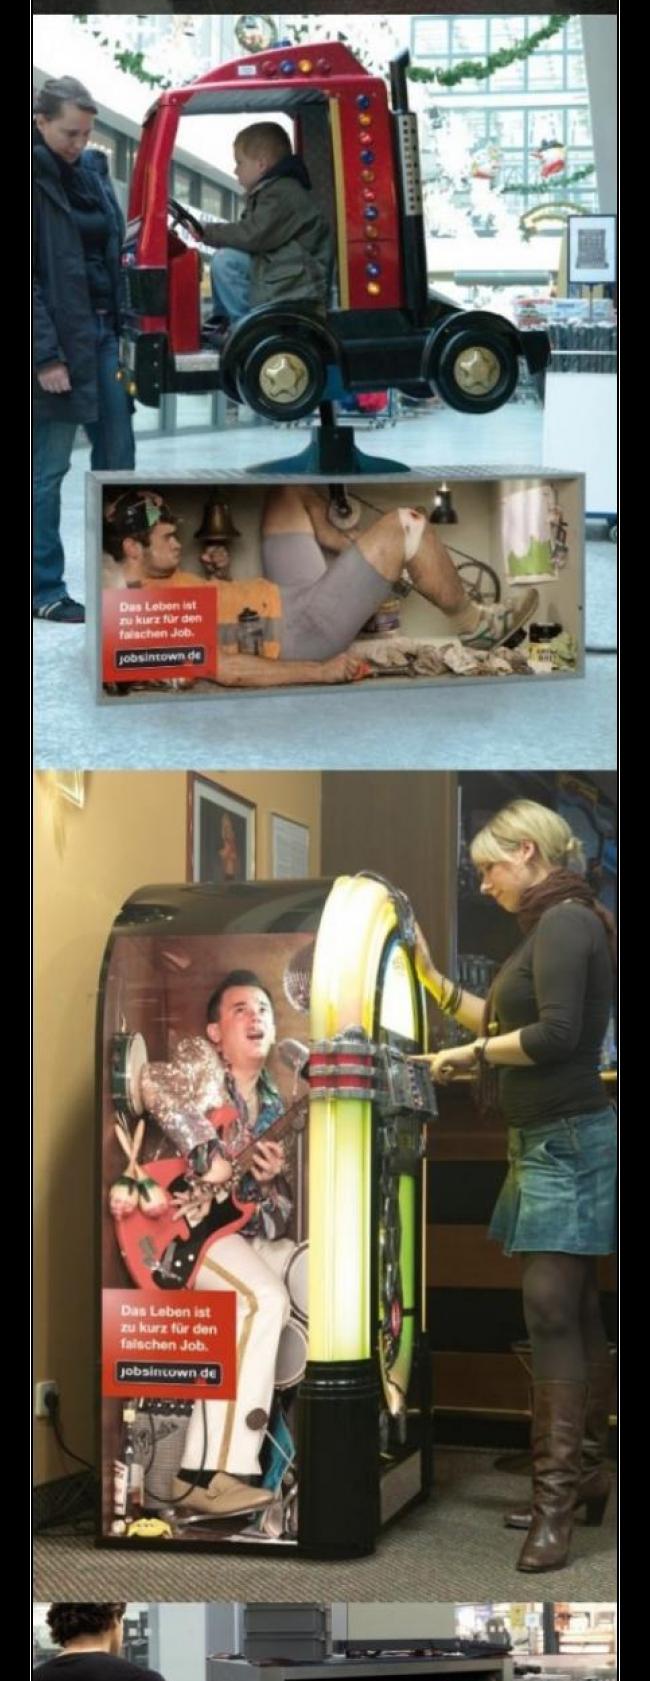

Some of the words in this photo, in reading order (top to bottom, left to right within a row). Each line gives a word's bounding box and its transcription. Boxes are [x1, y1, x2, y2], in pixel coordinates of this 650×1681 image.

[120, 601, 142, 612] Das
[145, 601, 180, 611] Leben
[182, 600, 197, 610] ist
[120, 617, 133, 625] zu
[135, 615, 160, 625] kurz
[163, 614, 179, 624] für
[181, 614, 202, 623] den
[119, 629, 168, 639] falschen
[170, 627, 195, 638] Job.
[121, 1304, 146, 1317] Das
[150, 1305, 191, 1318] Leben
[194, 1305, 211, 1318] ist
[121, 1323, 136, 1333] zu
[139, 1321, 168, 1334] kurz
[171, 1322, 189, 1334] für
[192, 1323, 217, 1335] den
[121, 1338, 176, 1351] falschen
[180, 1339, 208, 1352] Job.
